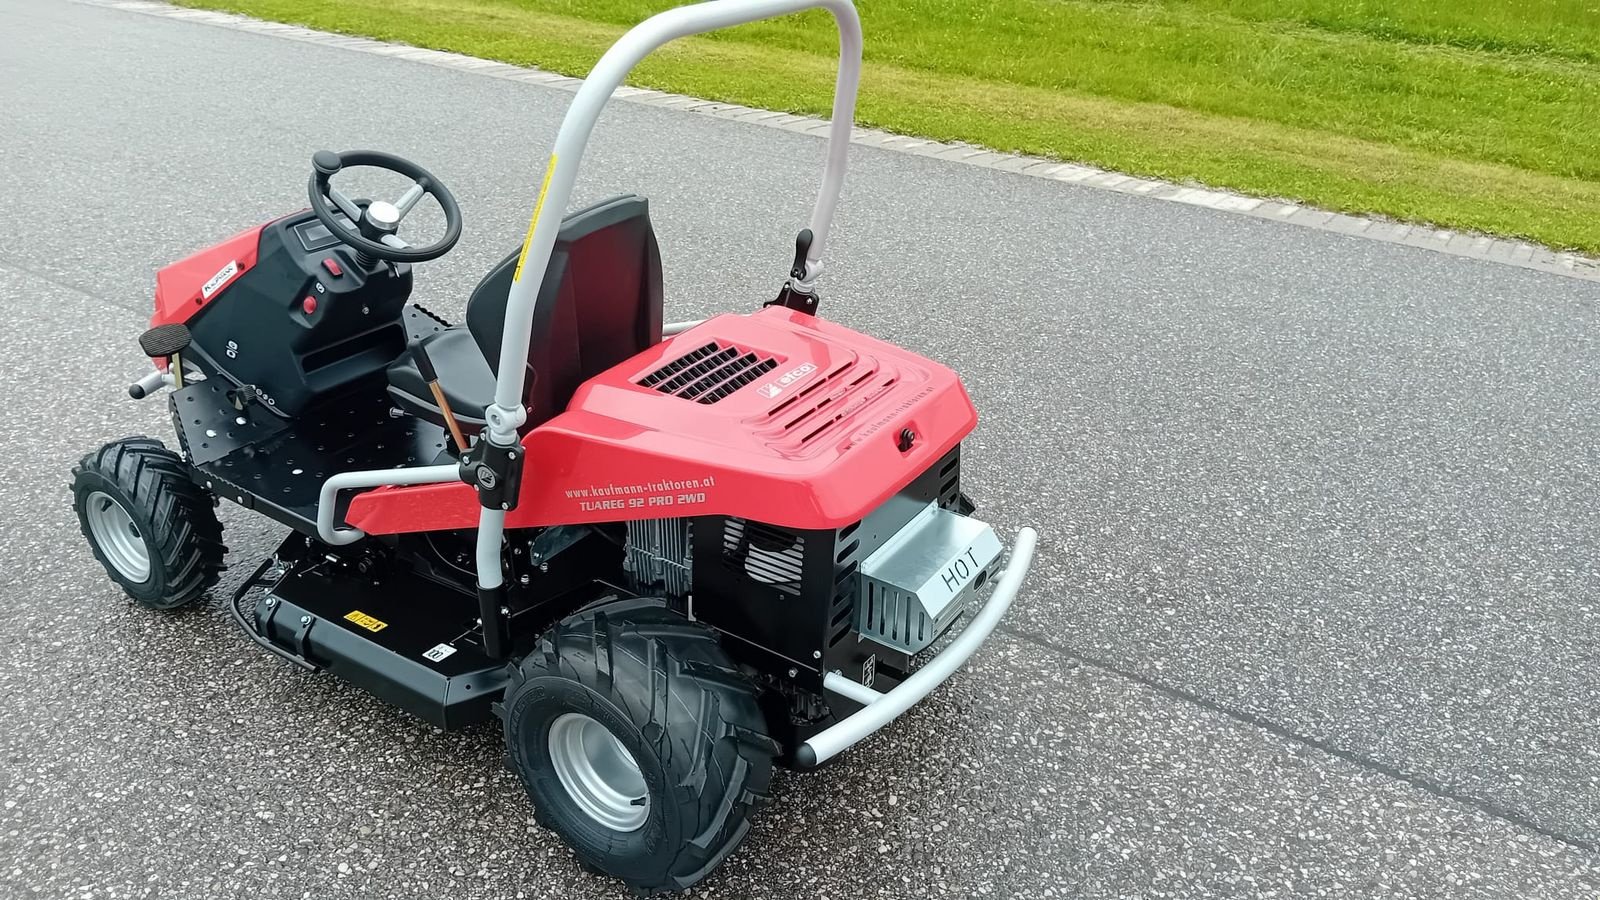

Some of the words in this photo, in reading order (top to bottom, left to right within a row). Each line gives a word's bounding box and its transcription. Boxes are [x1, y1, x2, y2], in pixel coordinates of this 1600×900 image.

[565, 476, 715, 498] www.kaufmann-traktoren.at
[580, 498, 625, 511] TUAREG
[628, 498, 645, 508] 92
[648, 495, 674, 506] PRO
[677, 492, 706, 504] 2WD
[941, 546, 979, 593] HOT
